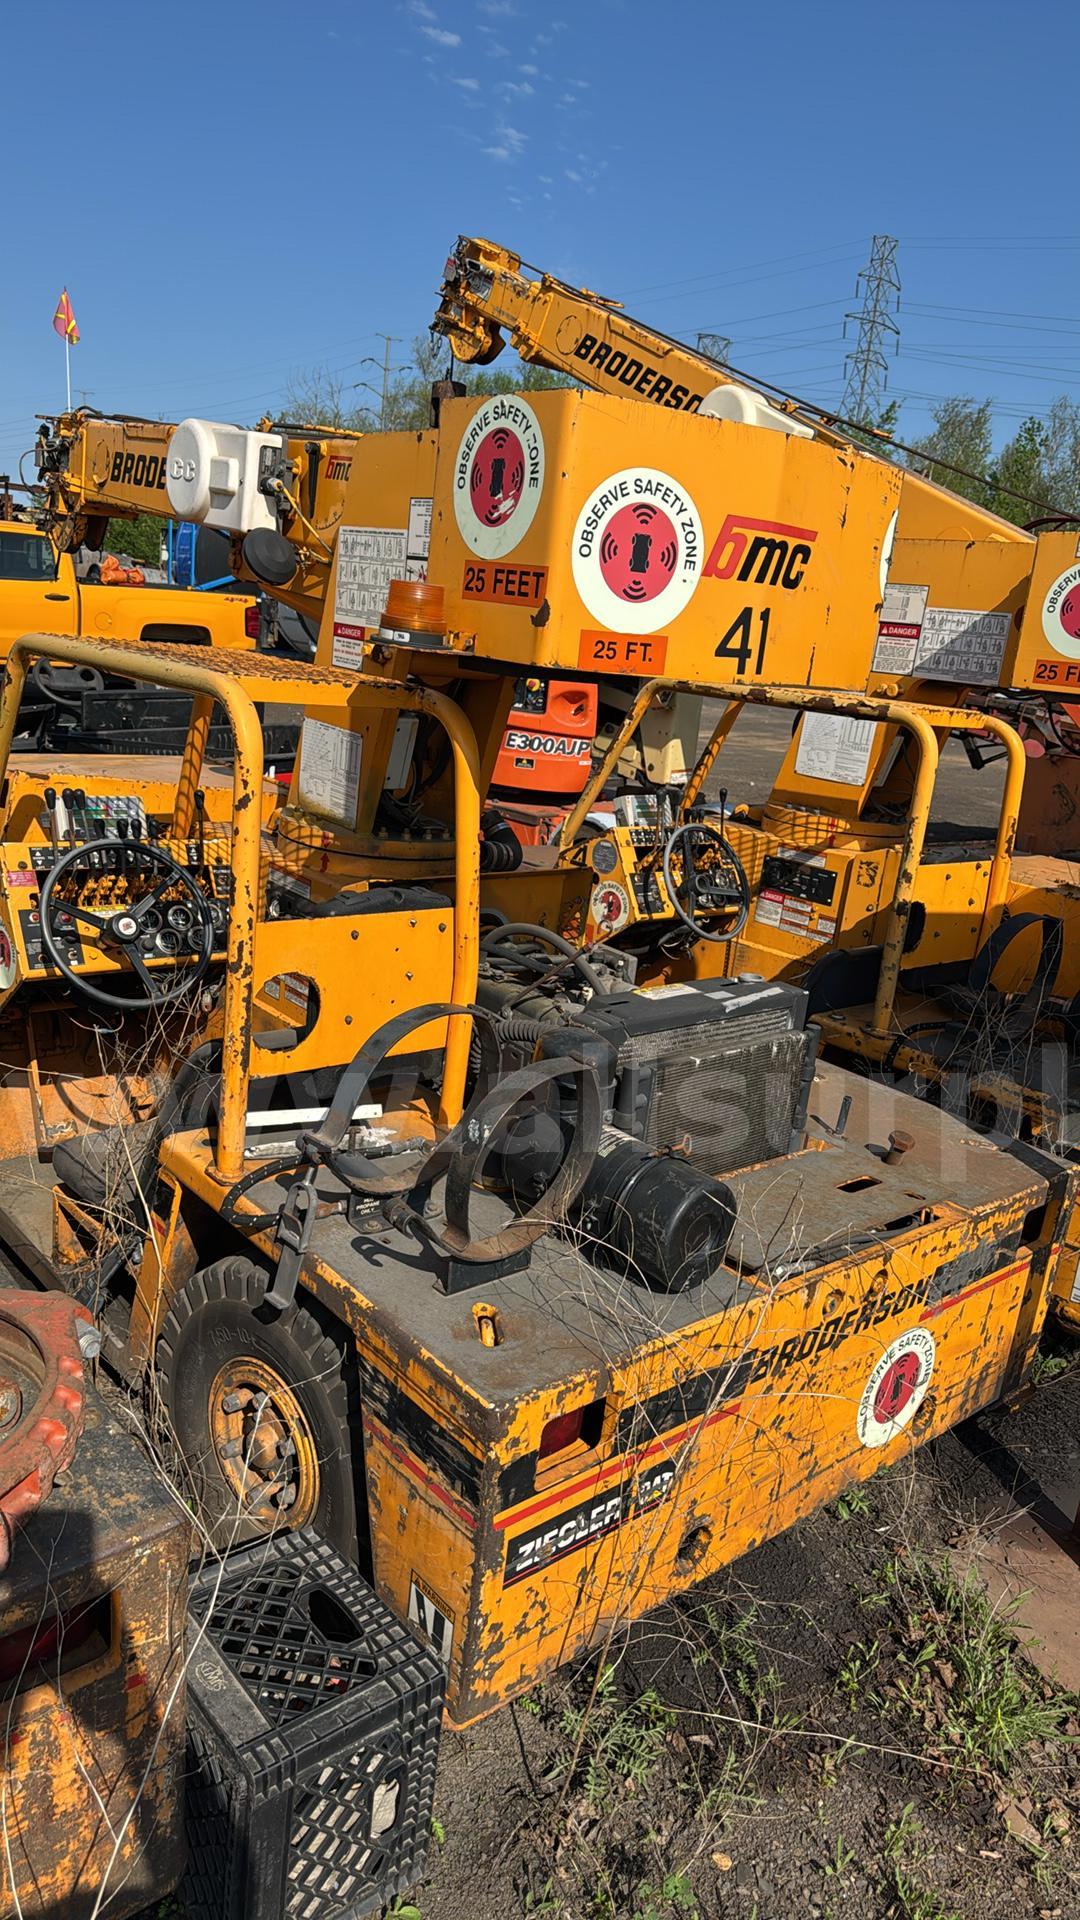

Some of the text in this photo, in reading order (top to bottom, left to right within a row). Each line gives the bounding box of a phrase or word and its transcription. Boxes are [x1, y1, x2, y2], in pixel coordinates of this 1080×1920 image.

[457, 410, 490, 489] OBSERVE
[493, 404, 532, 434] SAFETY
[579, 478, 697, 571] OBSERVE SAFETY ZONE
[465, 567, 544, 599] 25 FEET
[714, 607, 771, 675] 41
[889, 627, 917, 636] DANGER
[593, 641, 653, 662] 25 FT.
[1036, 664, 1058, 680] 25
[506, 732, 591, 757] E300AJP
[356, 1200, 380, 1210] PROPANE
[860, 1348, 896, 1417] OBSERVE
[898, 1334, 929, 1351] SAFETY
[421, 1583, 452, 1619] WARNING
